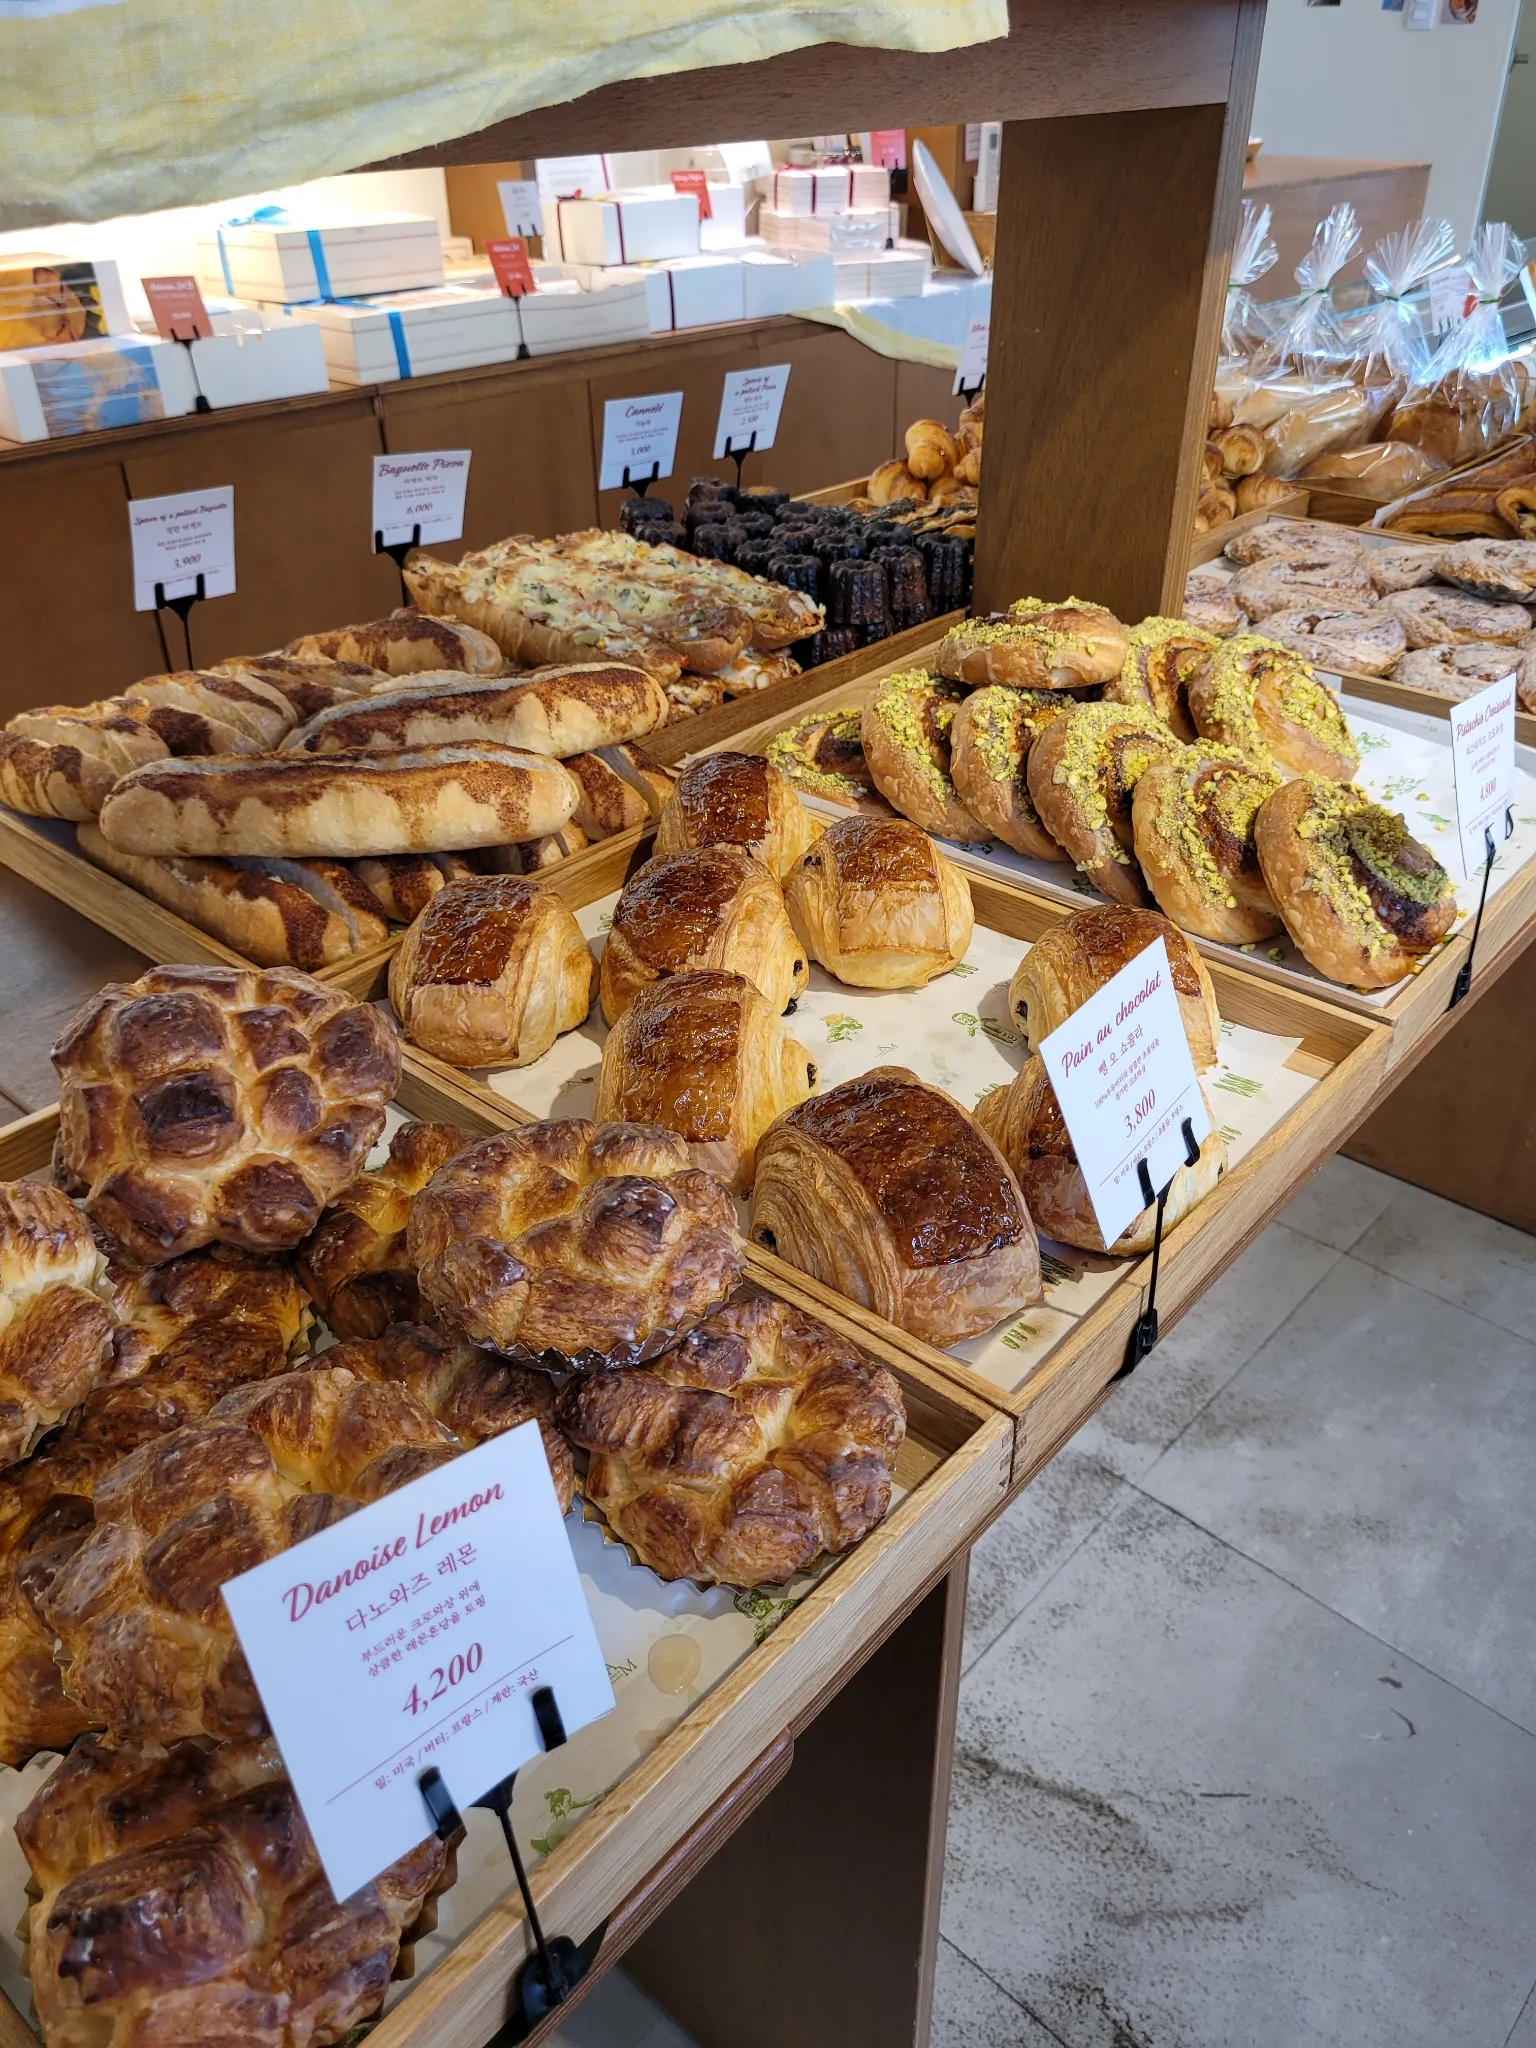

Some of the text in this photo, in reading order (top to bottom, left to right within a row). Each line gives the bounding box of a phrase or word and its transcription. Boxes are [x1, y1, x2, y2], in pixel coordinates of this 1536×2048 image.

[379, 459, 464, 477] Baguette Pizza
[406, 503, 433, 515] 6,000
[172, 554, 202, 570] 3,900
[1456, 713, 1484, 742] Pistachio
[1061, 970, 1161, 1078] Pain au chocolat
[1109, 1052, 1119, 1066] 오
[1120, 1024, 1143, 1056] 쇼콜라
[1124, 1088, 1155, 1138] 3,800
[282, 1483, 504, 1622] Danoise Lemon
[346, 1542, 477, 1631] 다노와즈 레몬
[362, 1580, 480, 1662] 부드러운 크로와상 위에
[369, 1648, 402, 1676] 상큼한
[465, 1594, 486, 1615] 토핑
[402, 1642, 483, 1716] 4,200
[374, 1774, 391, 1790] 밀:
[393, 1755, 415, 1776] 미국
[424, 1732, 450, 1753] 버터:
[451, 1707, 484, 1735] 프랑스
[490, 1684, 516, 1705] 계란:
[517, 1668, 539, 1688] 국산
